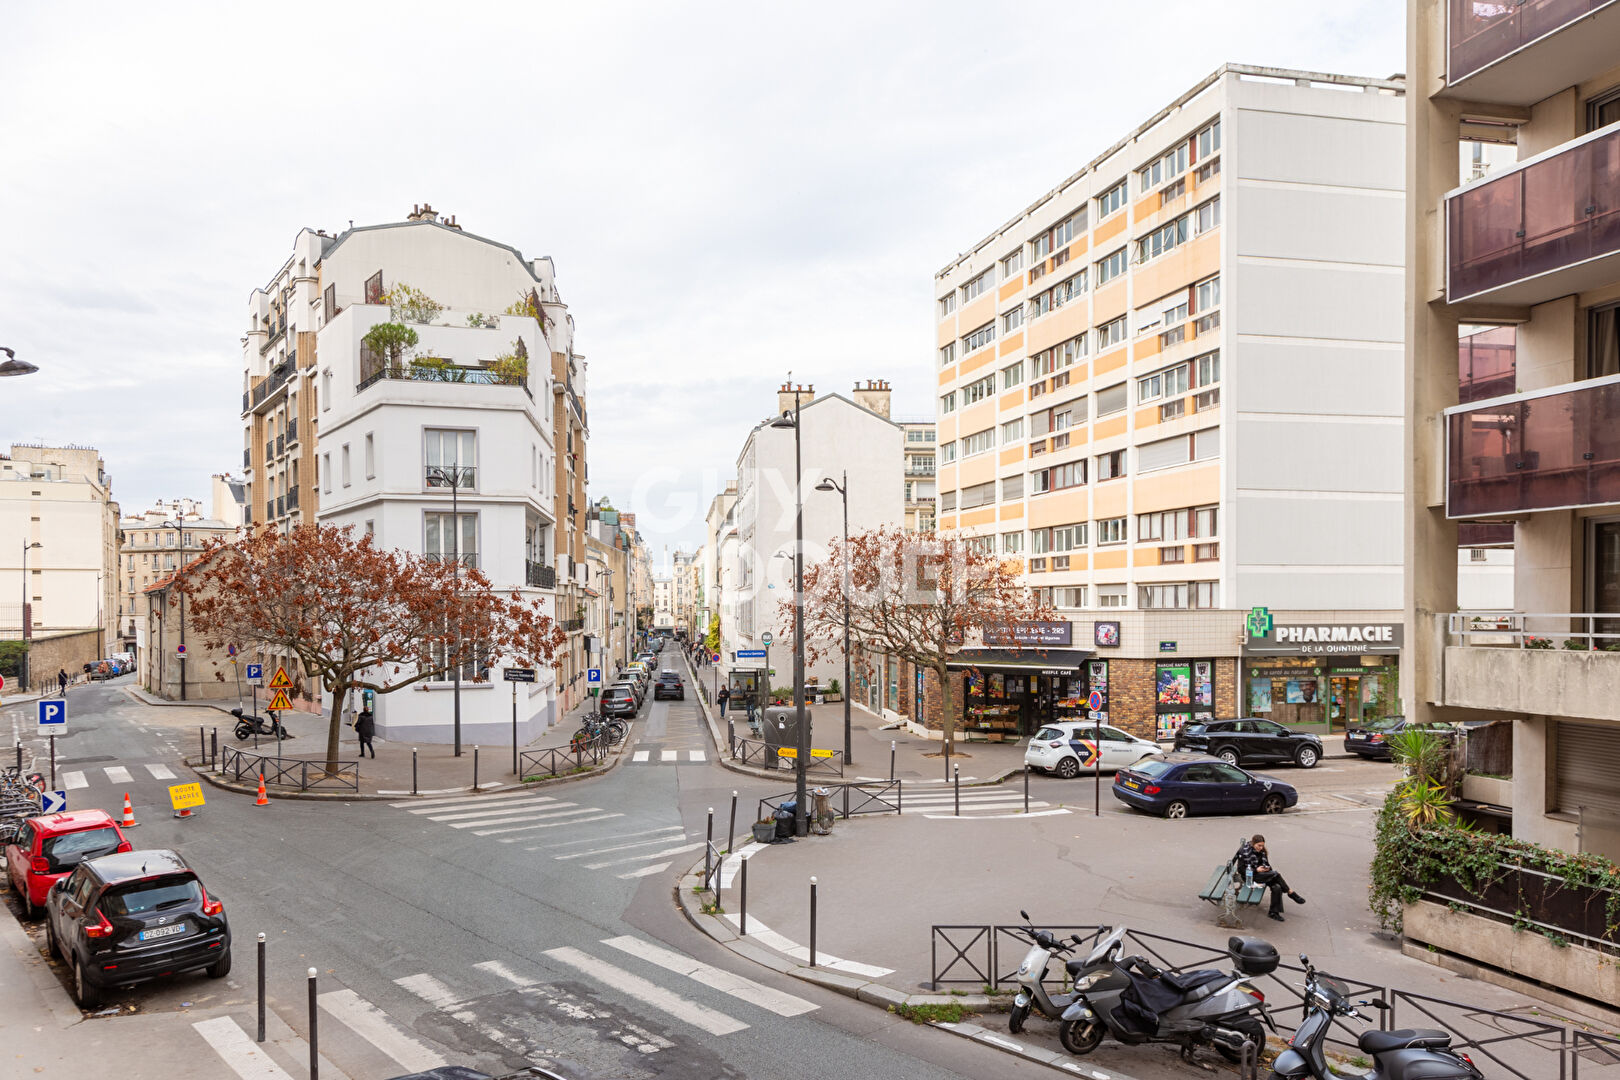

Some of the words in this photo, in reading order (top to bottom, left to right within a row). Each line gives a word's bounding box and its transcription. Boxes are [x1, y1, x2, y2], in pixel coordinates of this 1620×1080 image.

[1276, 626, 1393, 643] PHARMACIE
[251, 667, 258, 676] P
[591, 671, 597, 680] P
[45, 704, 59, 721] P
